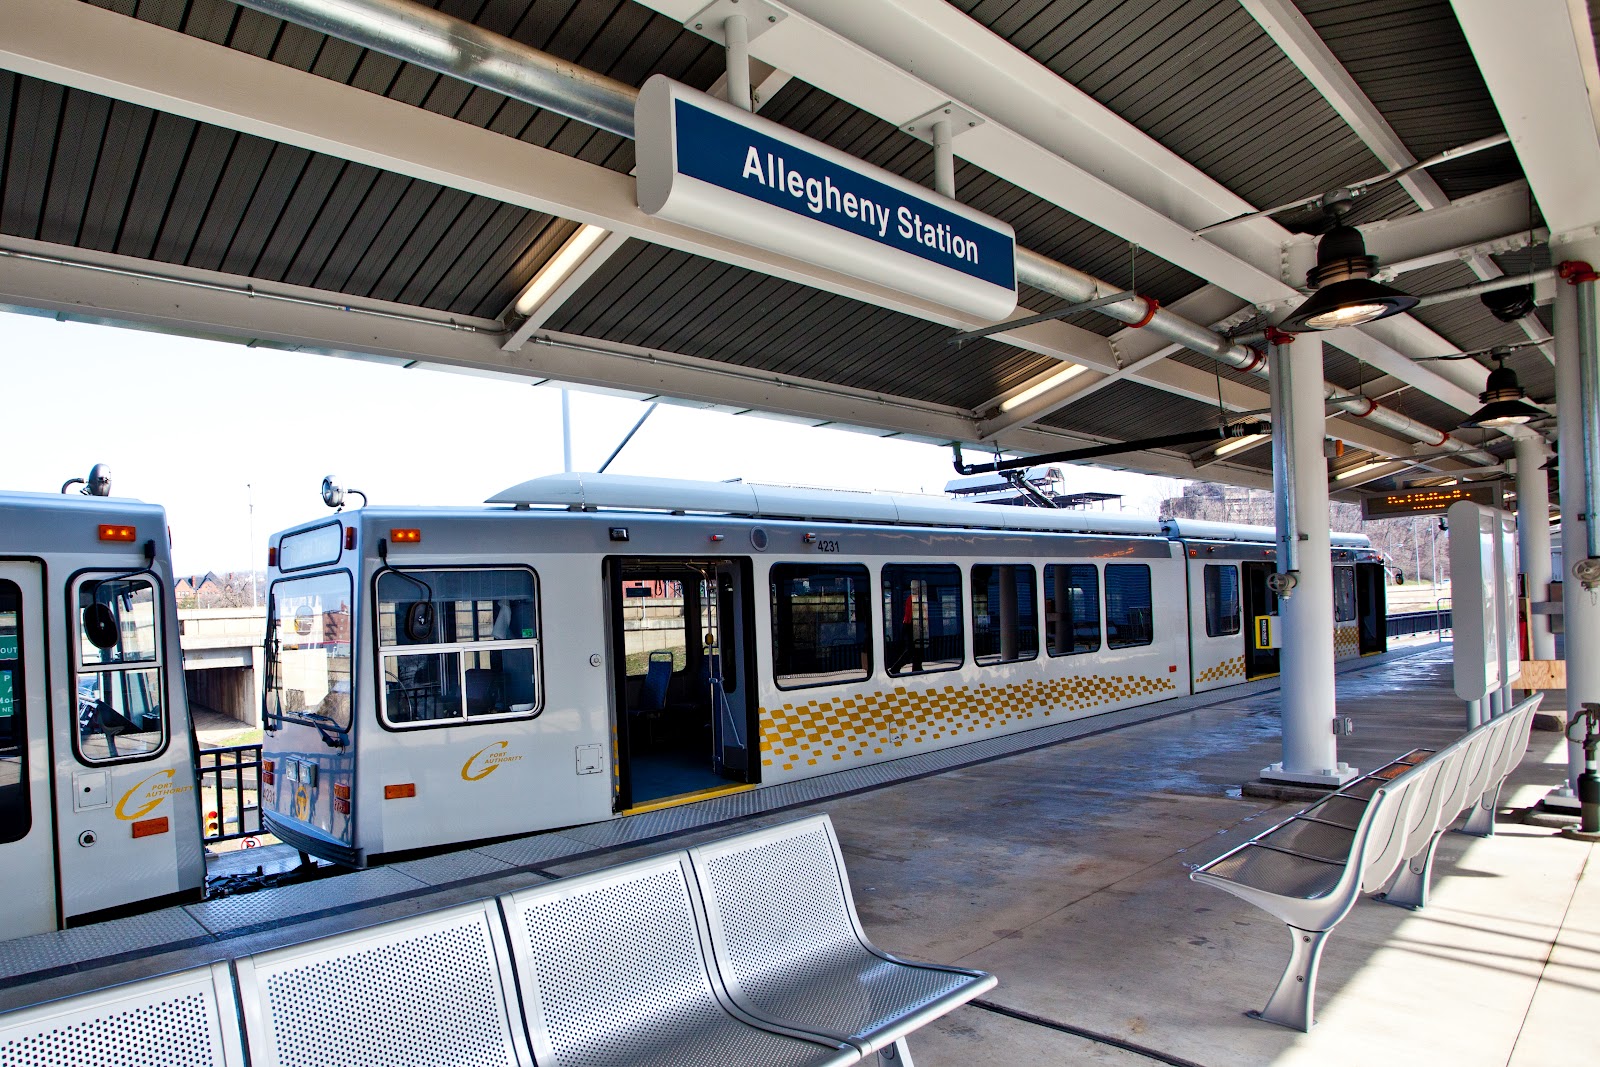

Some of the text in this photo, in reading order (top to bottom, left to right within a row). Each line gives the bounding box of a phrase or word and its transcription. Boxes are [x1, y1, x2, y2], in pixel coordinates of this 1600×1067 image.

[742, 145, 979, 265] Allegheny Station
[817, 540, 840, 552] 4231
[485, 756, 523, 764] AUTHORITY
[145, 785, 194, 798] AUTHORITY
[151, 782, 173, 790] PORT
